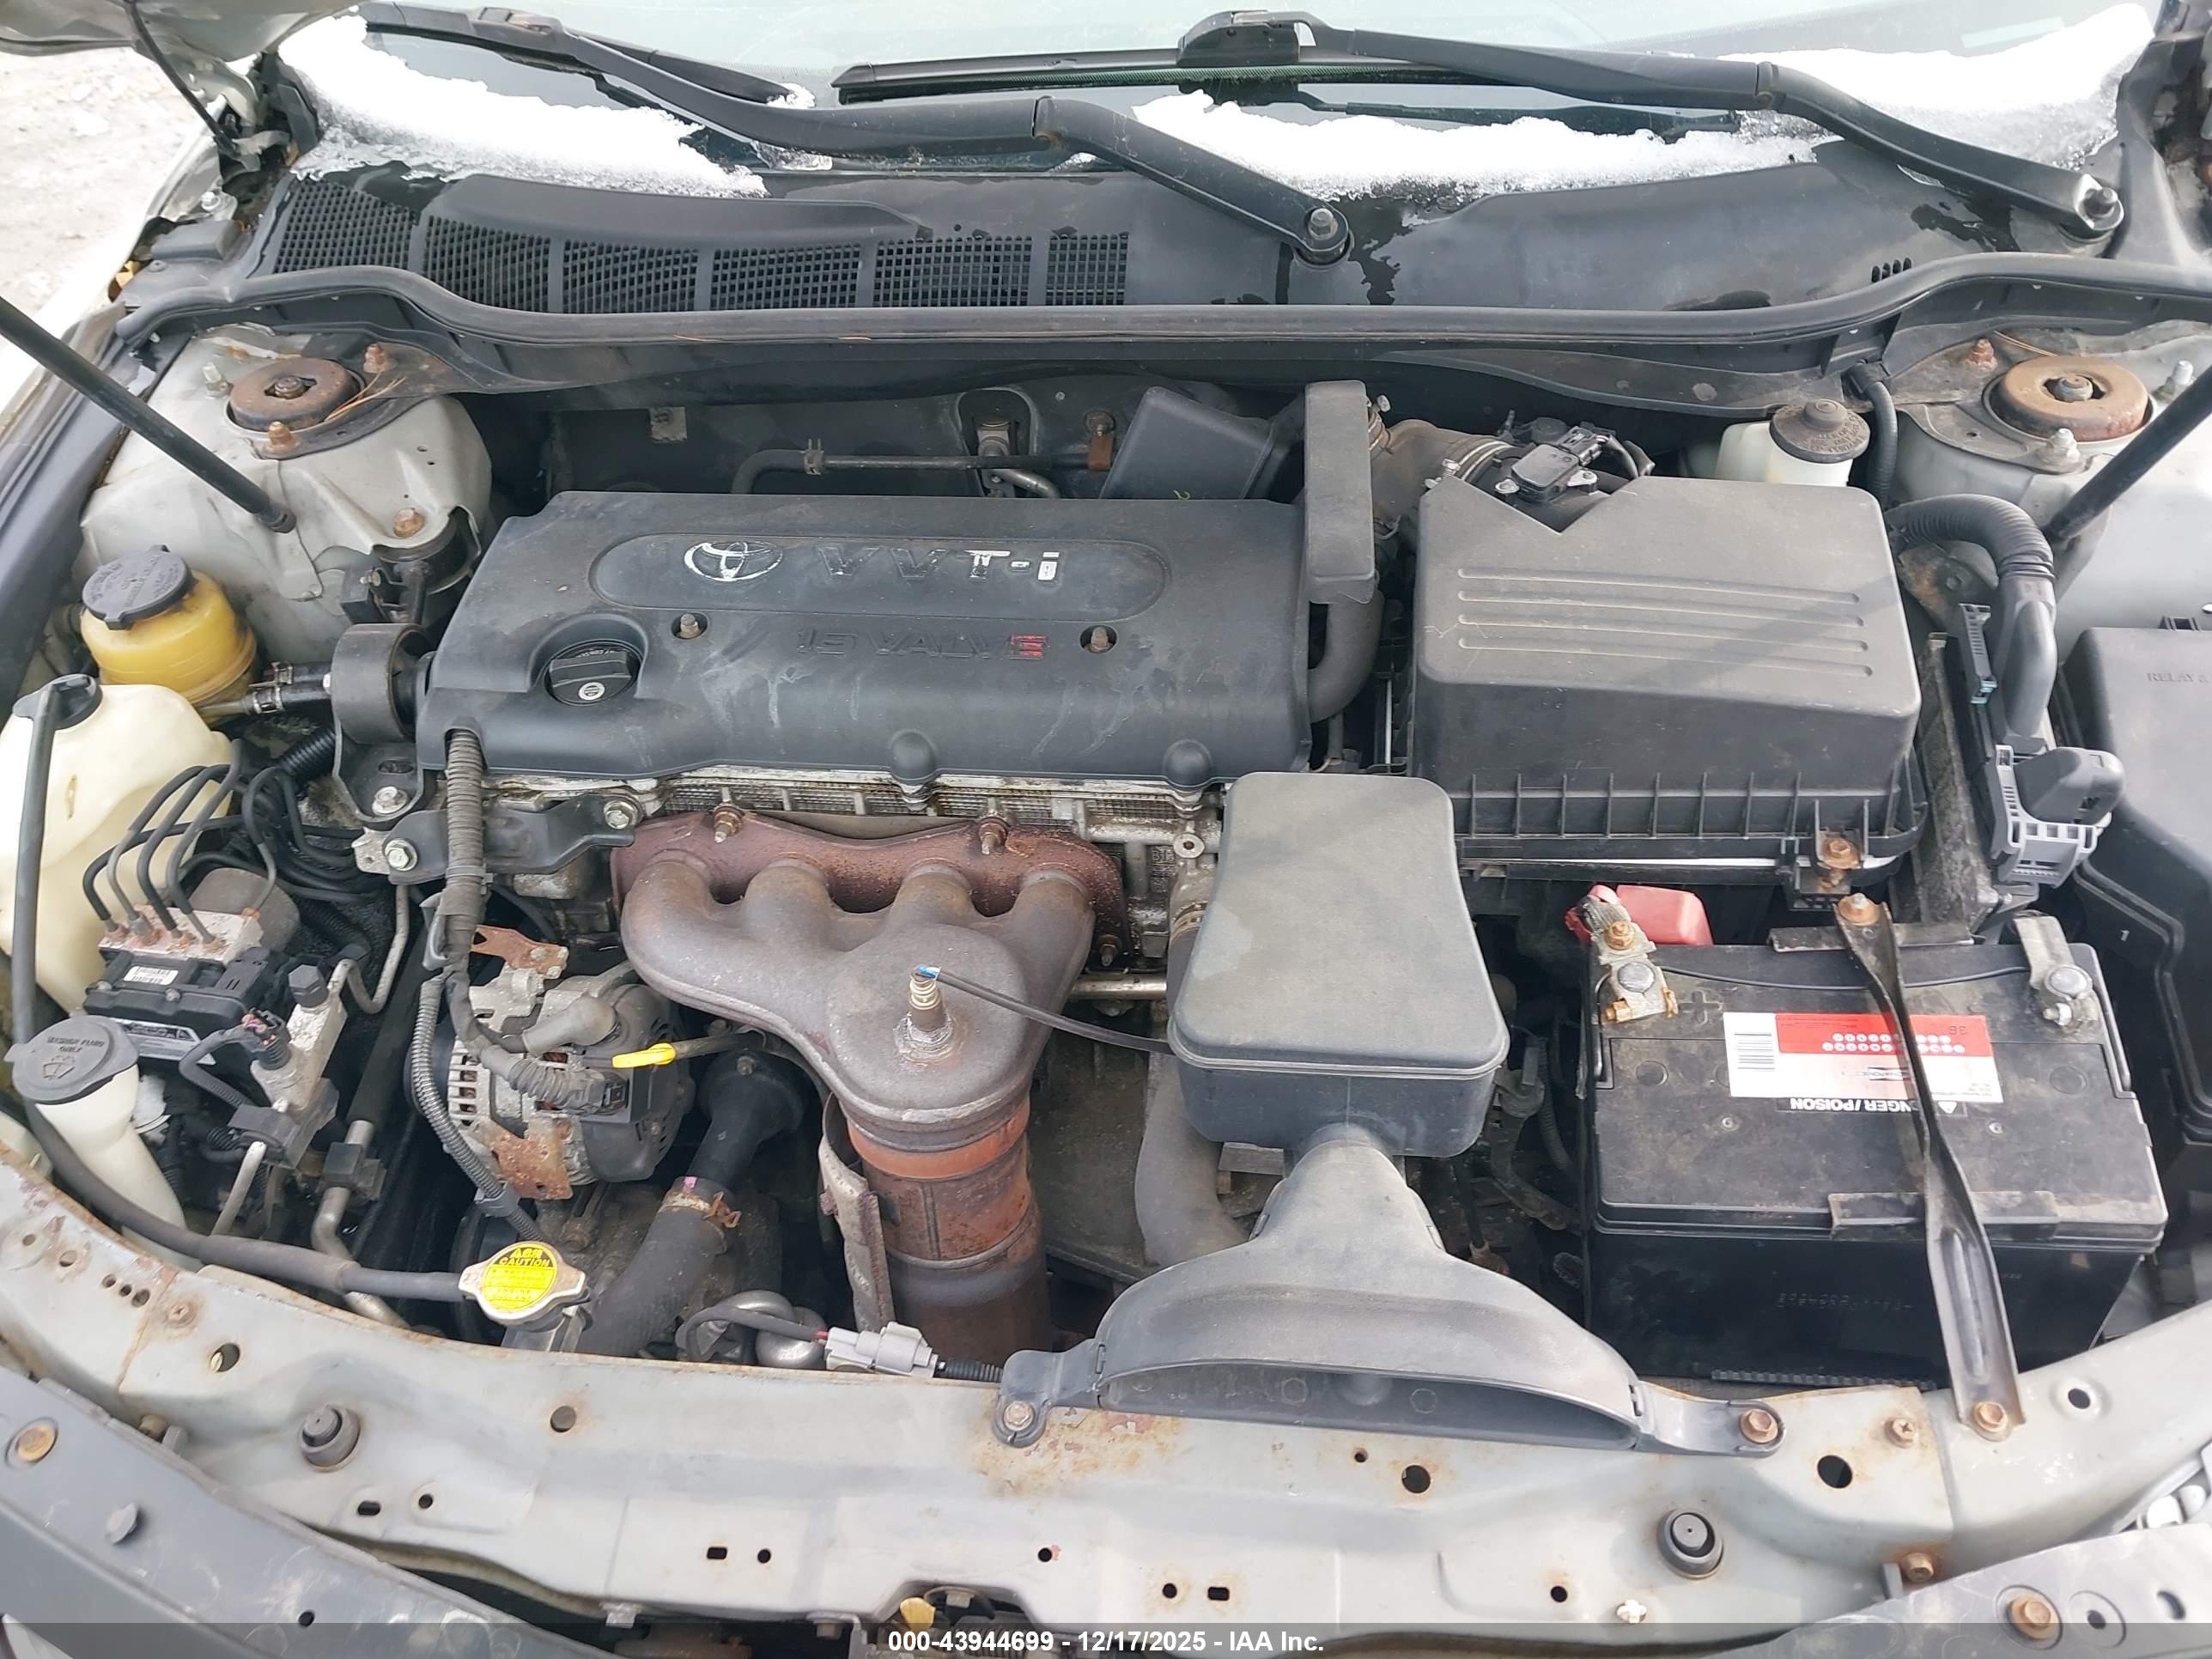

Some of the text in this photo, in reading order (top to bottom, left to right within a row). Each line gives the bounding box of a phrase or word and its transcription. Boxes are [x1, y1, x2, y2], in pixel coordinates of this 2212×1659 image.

[817, 545, 1060, 581] VVT-i
[866, 631, 1048, 660] VALVE
[498, 1256, 550, 1267] CAUTION
